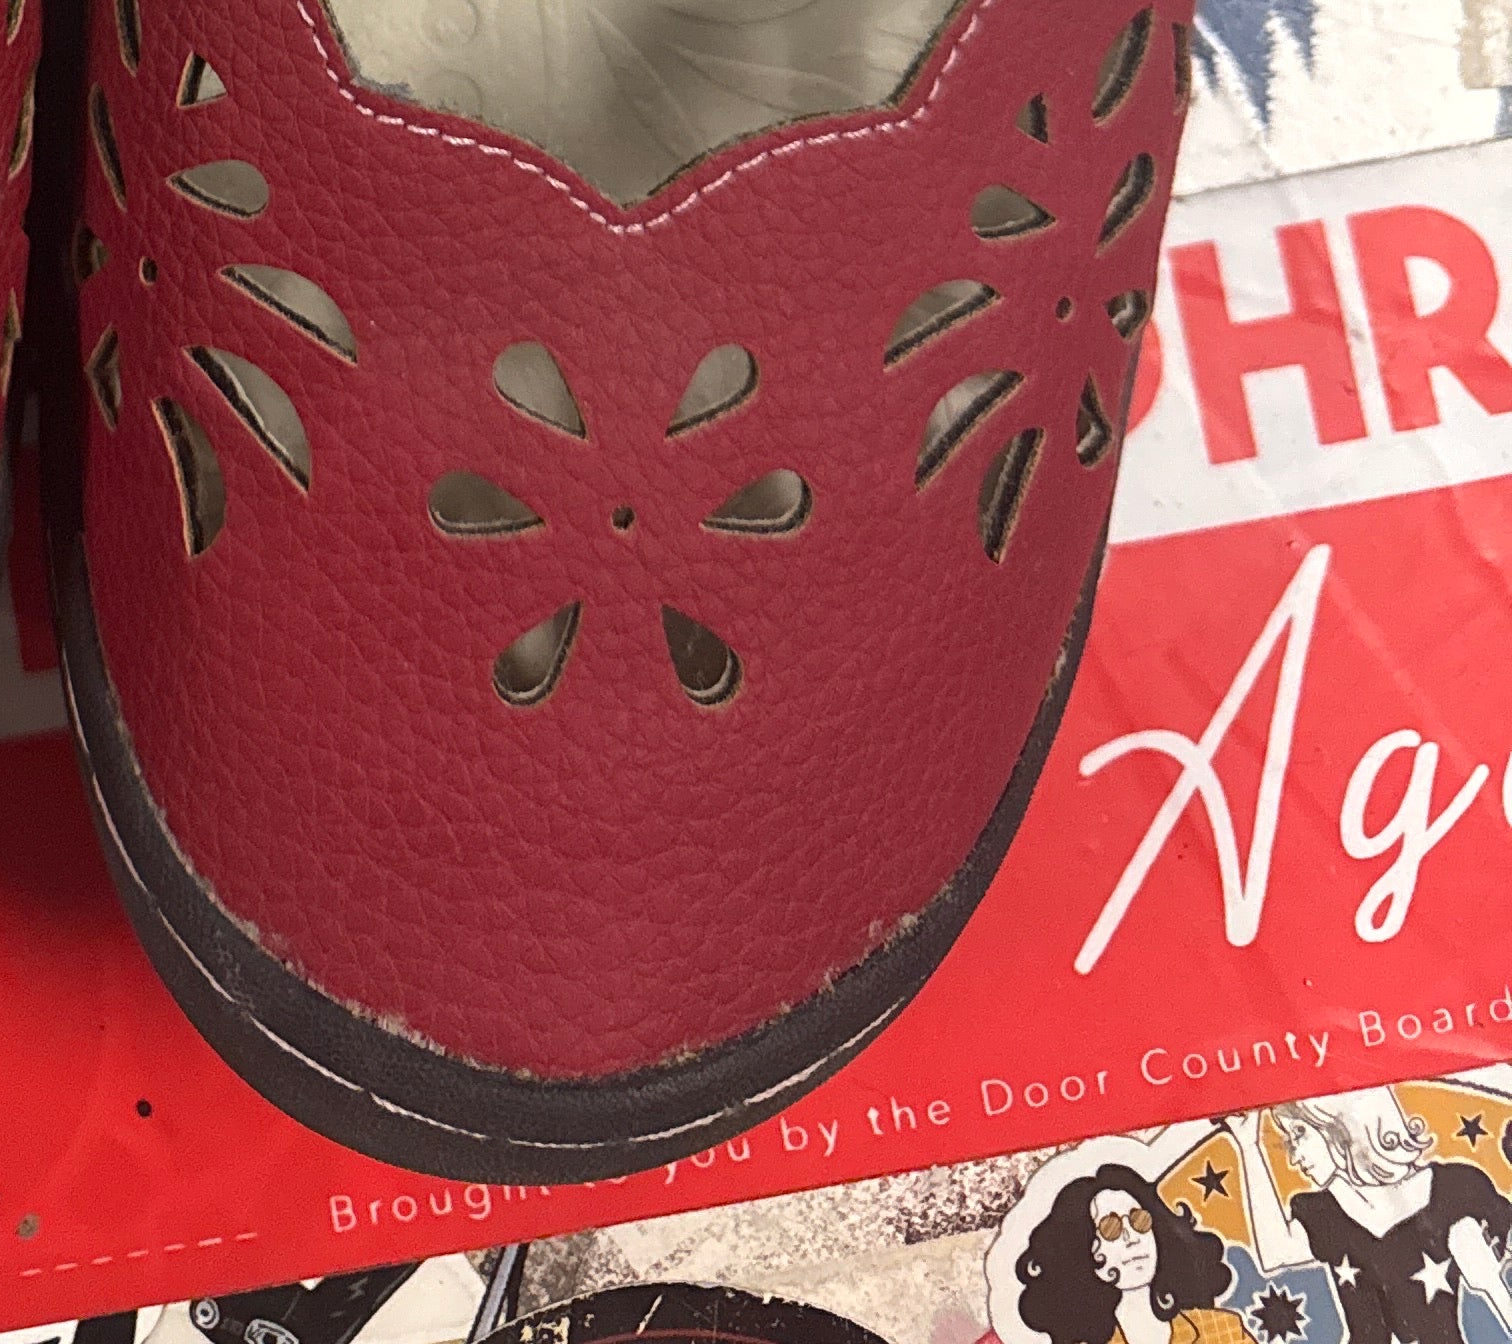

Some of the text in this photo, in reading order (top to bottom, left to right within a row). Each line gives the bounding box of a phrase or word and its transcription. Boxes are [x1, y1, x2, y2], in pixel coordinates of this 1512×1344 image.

[1074, 543, 1512, 976] Ag
[781, 1115, 839, 1157] by
[866, 1095, 952, 1136] the
[980, 1070, 1110, 1116] Door
[1140, 1030, 1329, 1085] County
[1358, 983, 1512, 1047] Board
